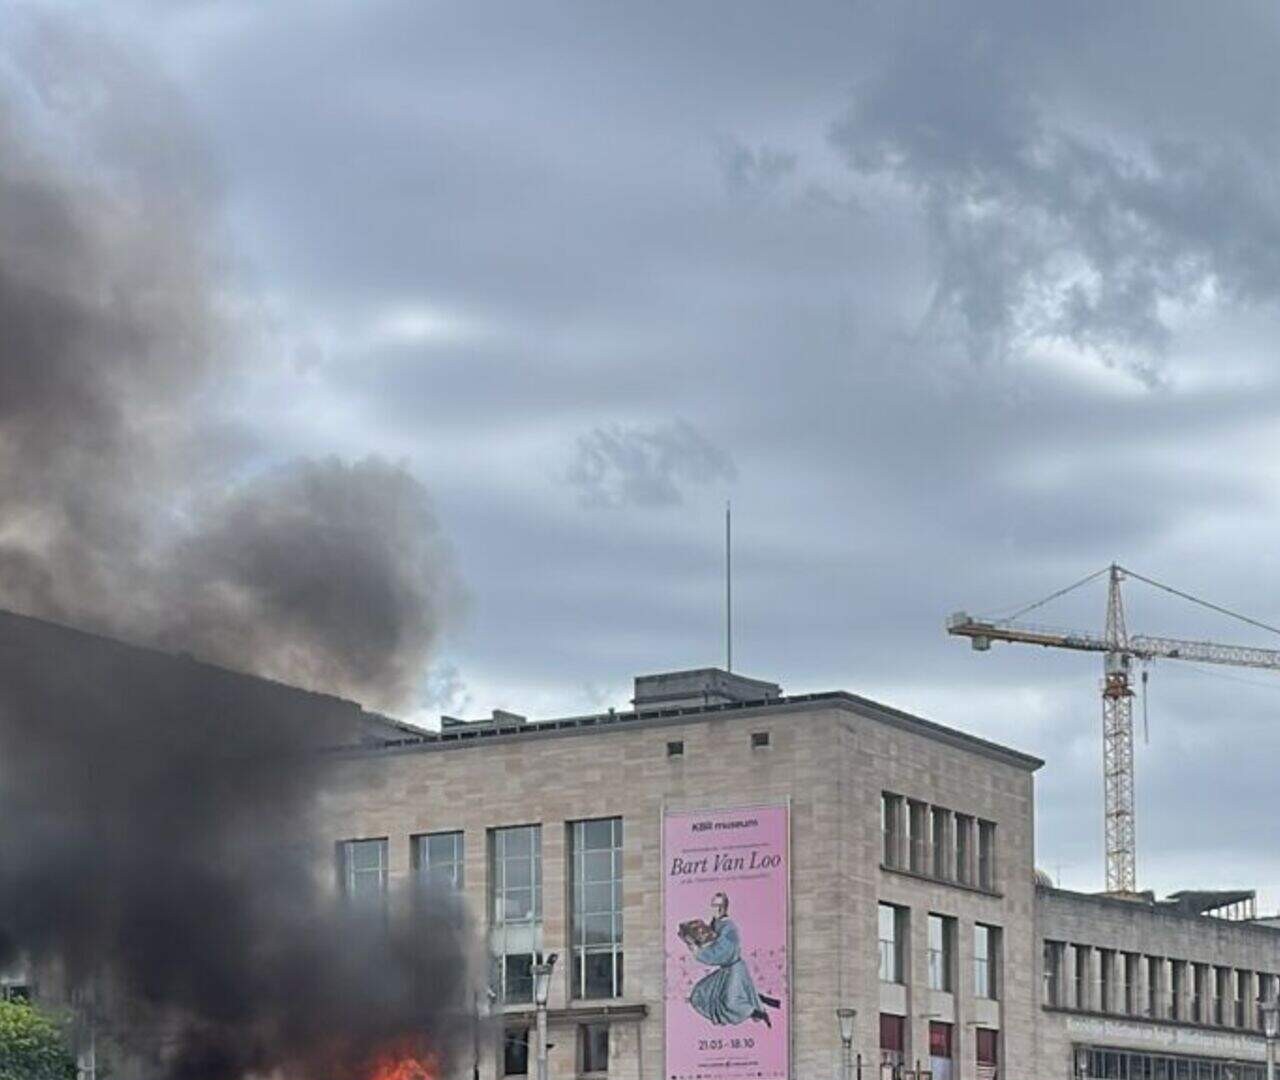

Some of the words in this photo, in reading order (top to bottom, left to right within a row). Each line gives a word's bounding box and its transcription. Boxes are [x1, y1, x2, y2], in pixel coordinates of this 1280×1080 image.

[671, 857, 708, 876] Bart
[714, 853, 744, 872] Van
[749, 851, 782, 870] Loo
